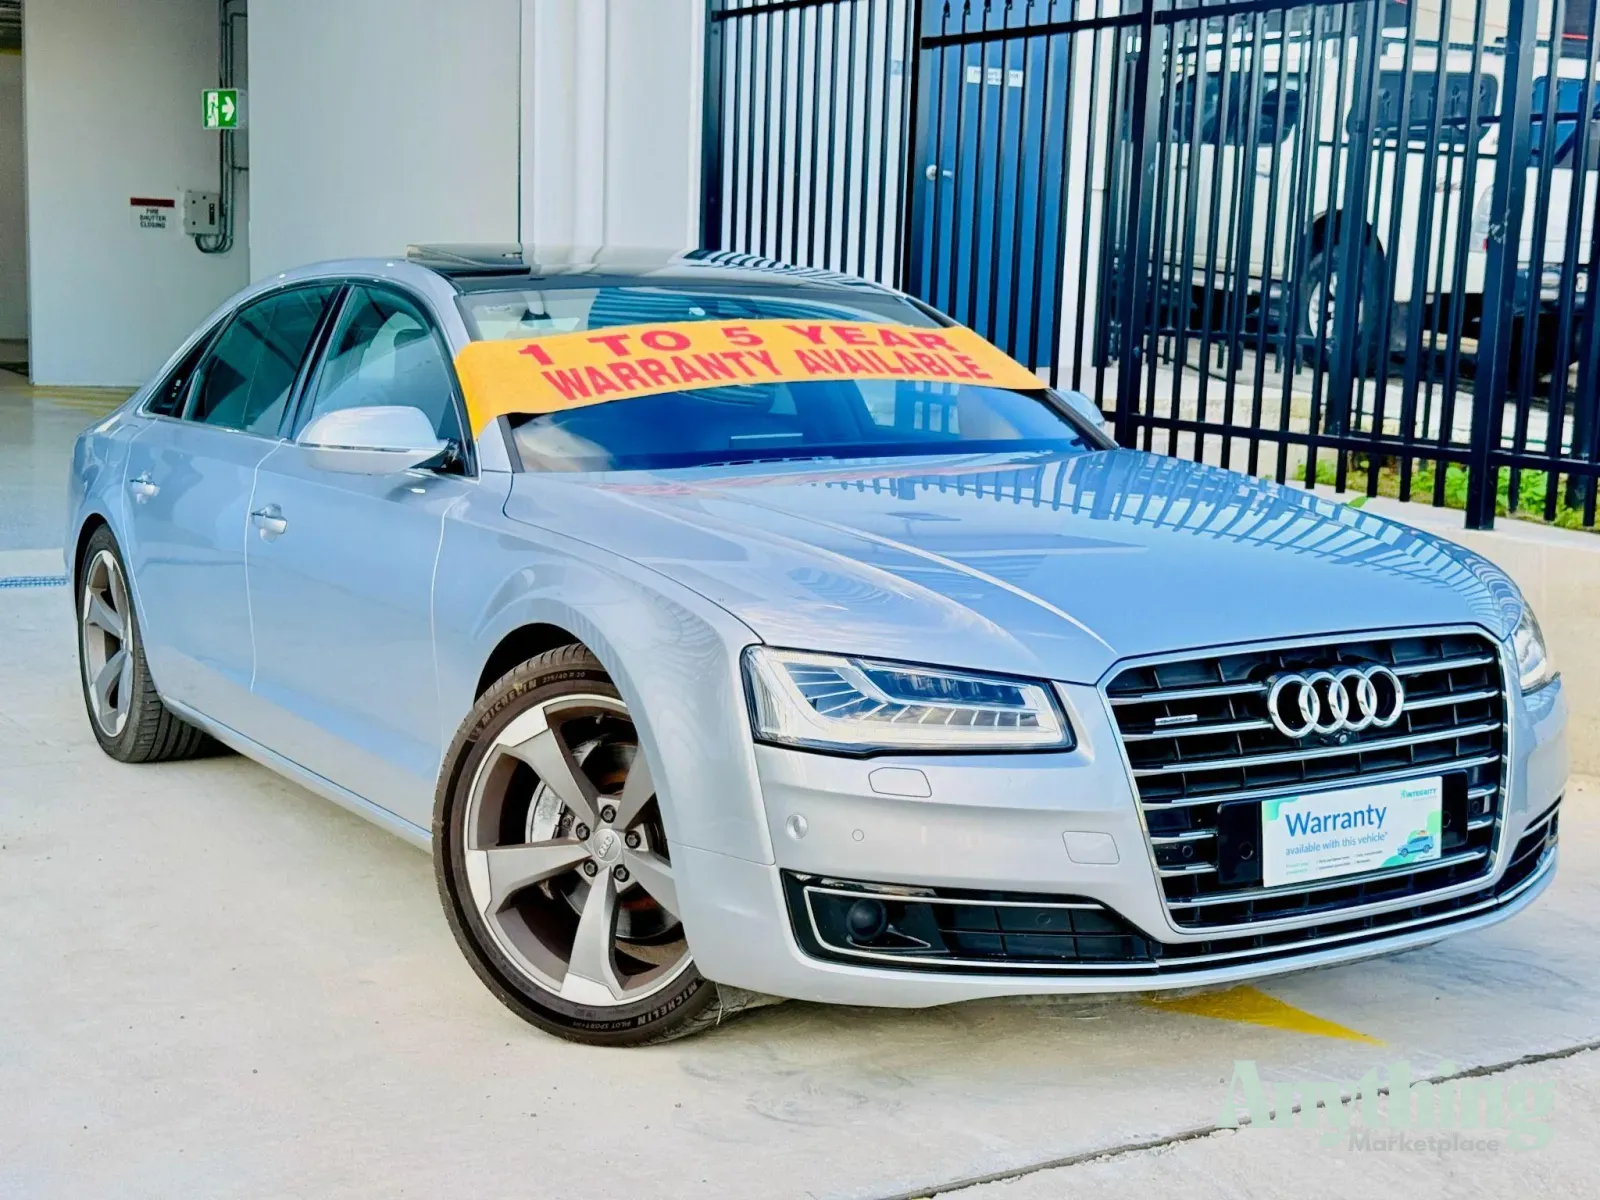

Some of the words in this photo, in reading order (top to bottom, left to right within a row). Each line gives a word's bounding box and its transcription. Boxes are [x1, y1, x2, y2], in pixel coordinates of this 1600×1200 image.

[519, 344, 555, 366] 1
[586, 331, 691, 357] TO
[721, 326, 765, 347] 5
[783, 325, 960, 352] YEAR
[541, 350, 783, 401] WARRANTY
[794, 349, 993, 380] AVAILABLE
[482, 679, 537, 724] MICHELIN
[1406, 788, 1437, 798] INTEGRITY
[1285, 804, 1387, 837] Warranty
[1286, 840, 1321, 856] available
[1322, 837, 1340, 849] with
[1342, 835, 1357, 848] this
[637, 981, 698, 1025] MICHELIN
[612, 1021, 632, 1029] PILOT
